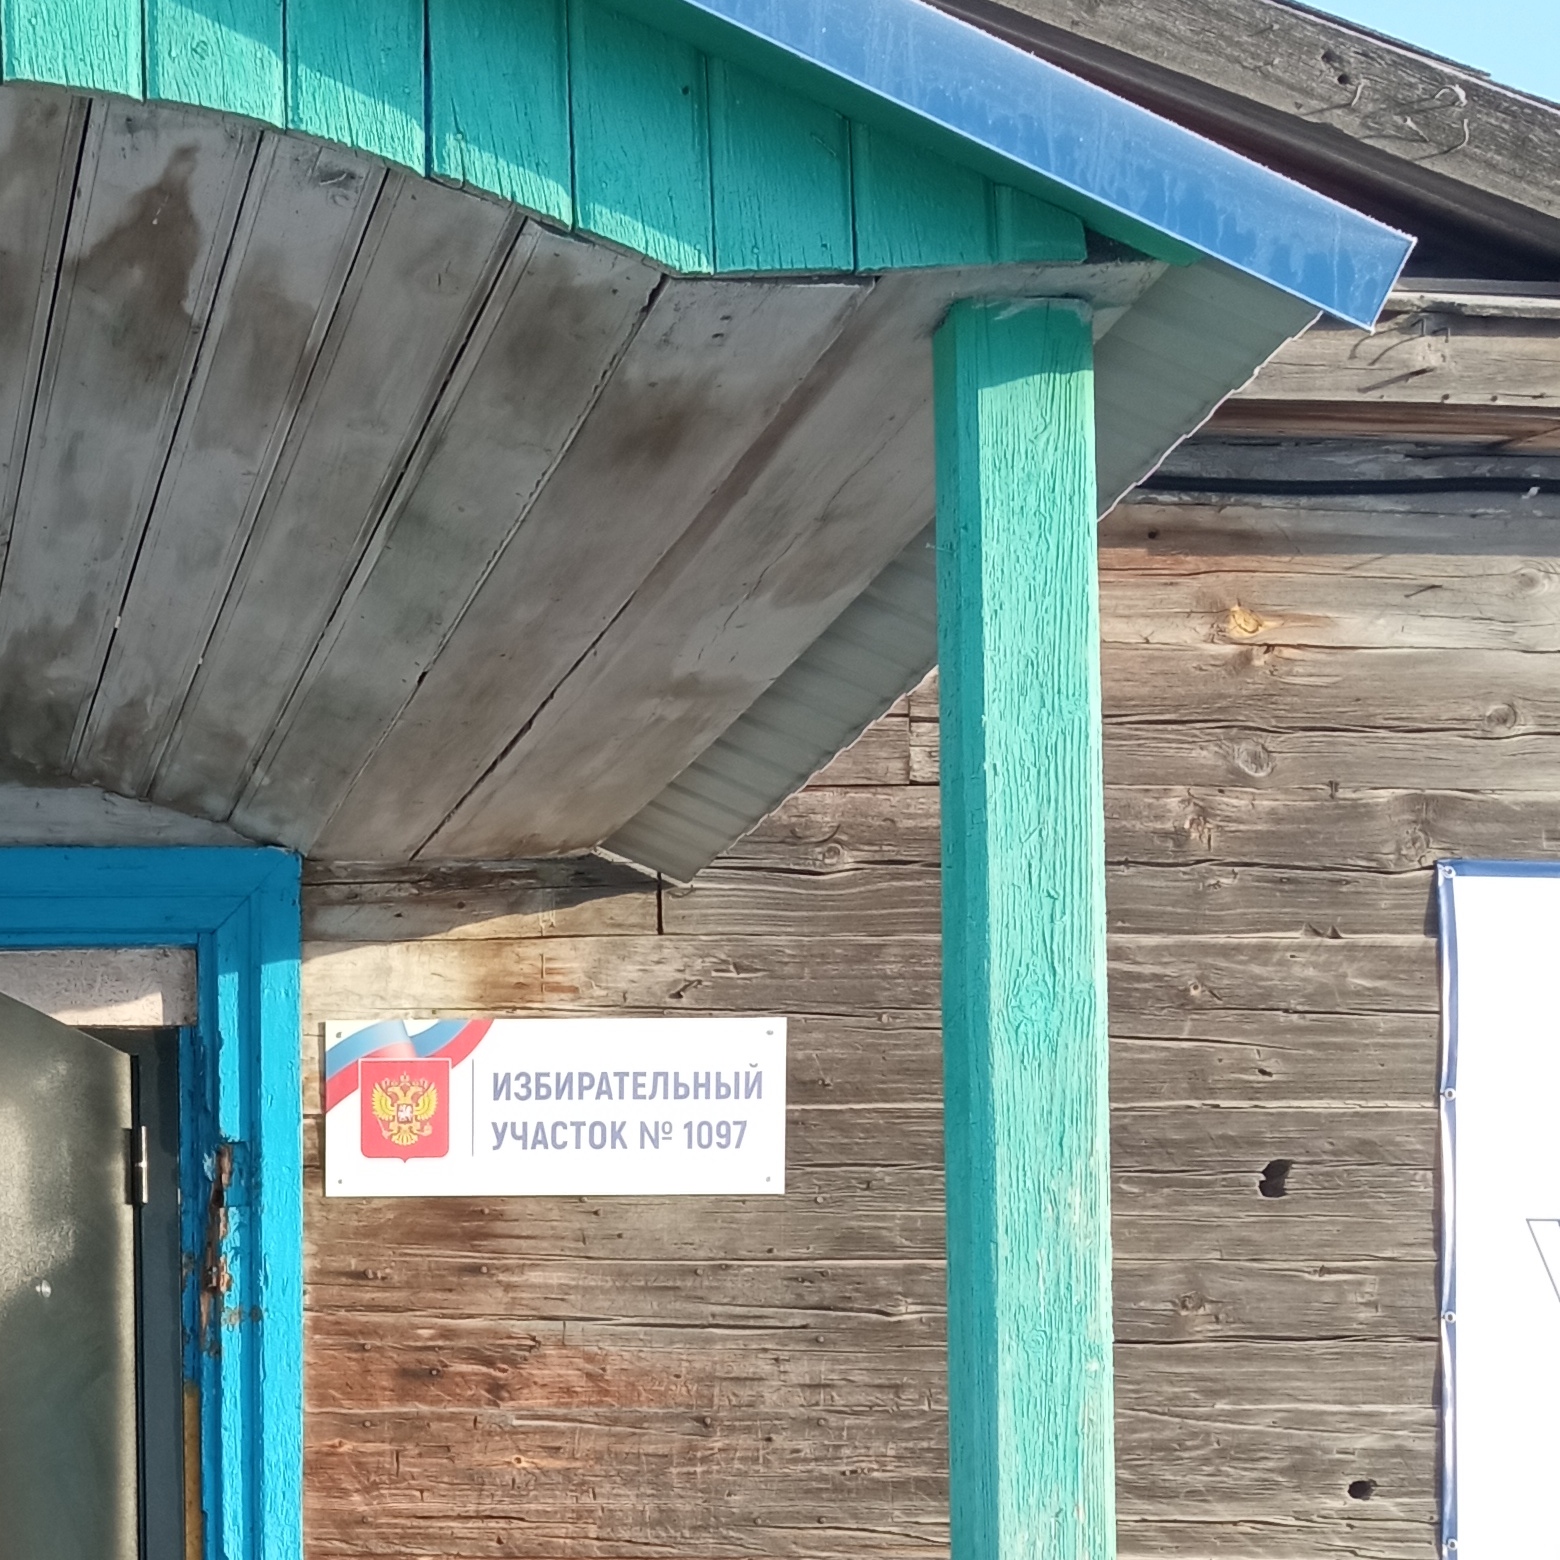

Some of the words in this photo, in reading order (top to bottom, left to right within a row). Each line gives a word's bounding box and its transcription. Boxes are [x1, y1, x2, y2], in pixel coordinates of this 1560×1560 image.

[492, 1063, 764, 1101] ИЗБИРАТЕЛЬНЫЙ
[491, 1121, 628, 1151] УЧАСТОК
[639, 1121, 673, 1150] №
[683, 1120, 748, 1150] 1097
